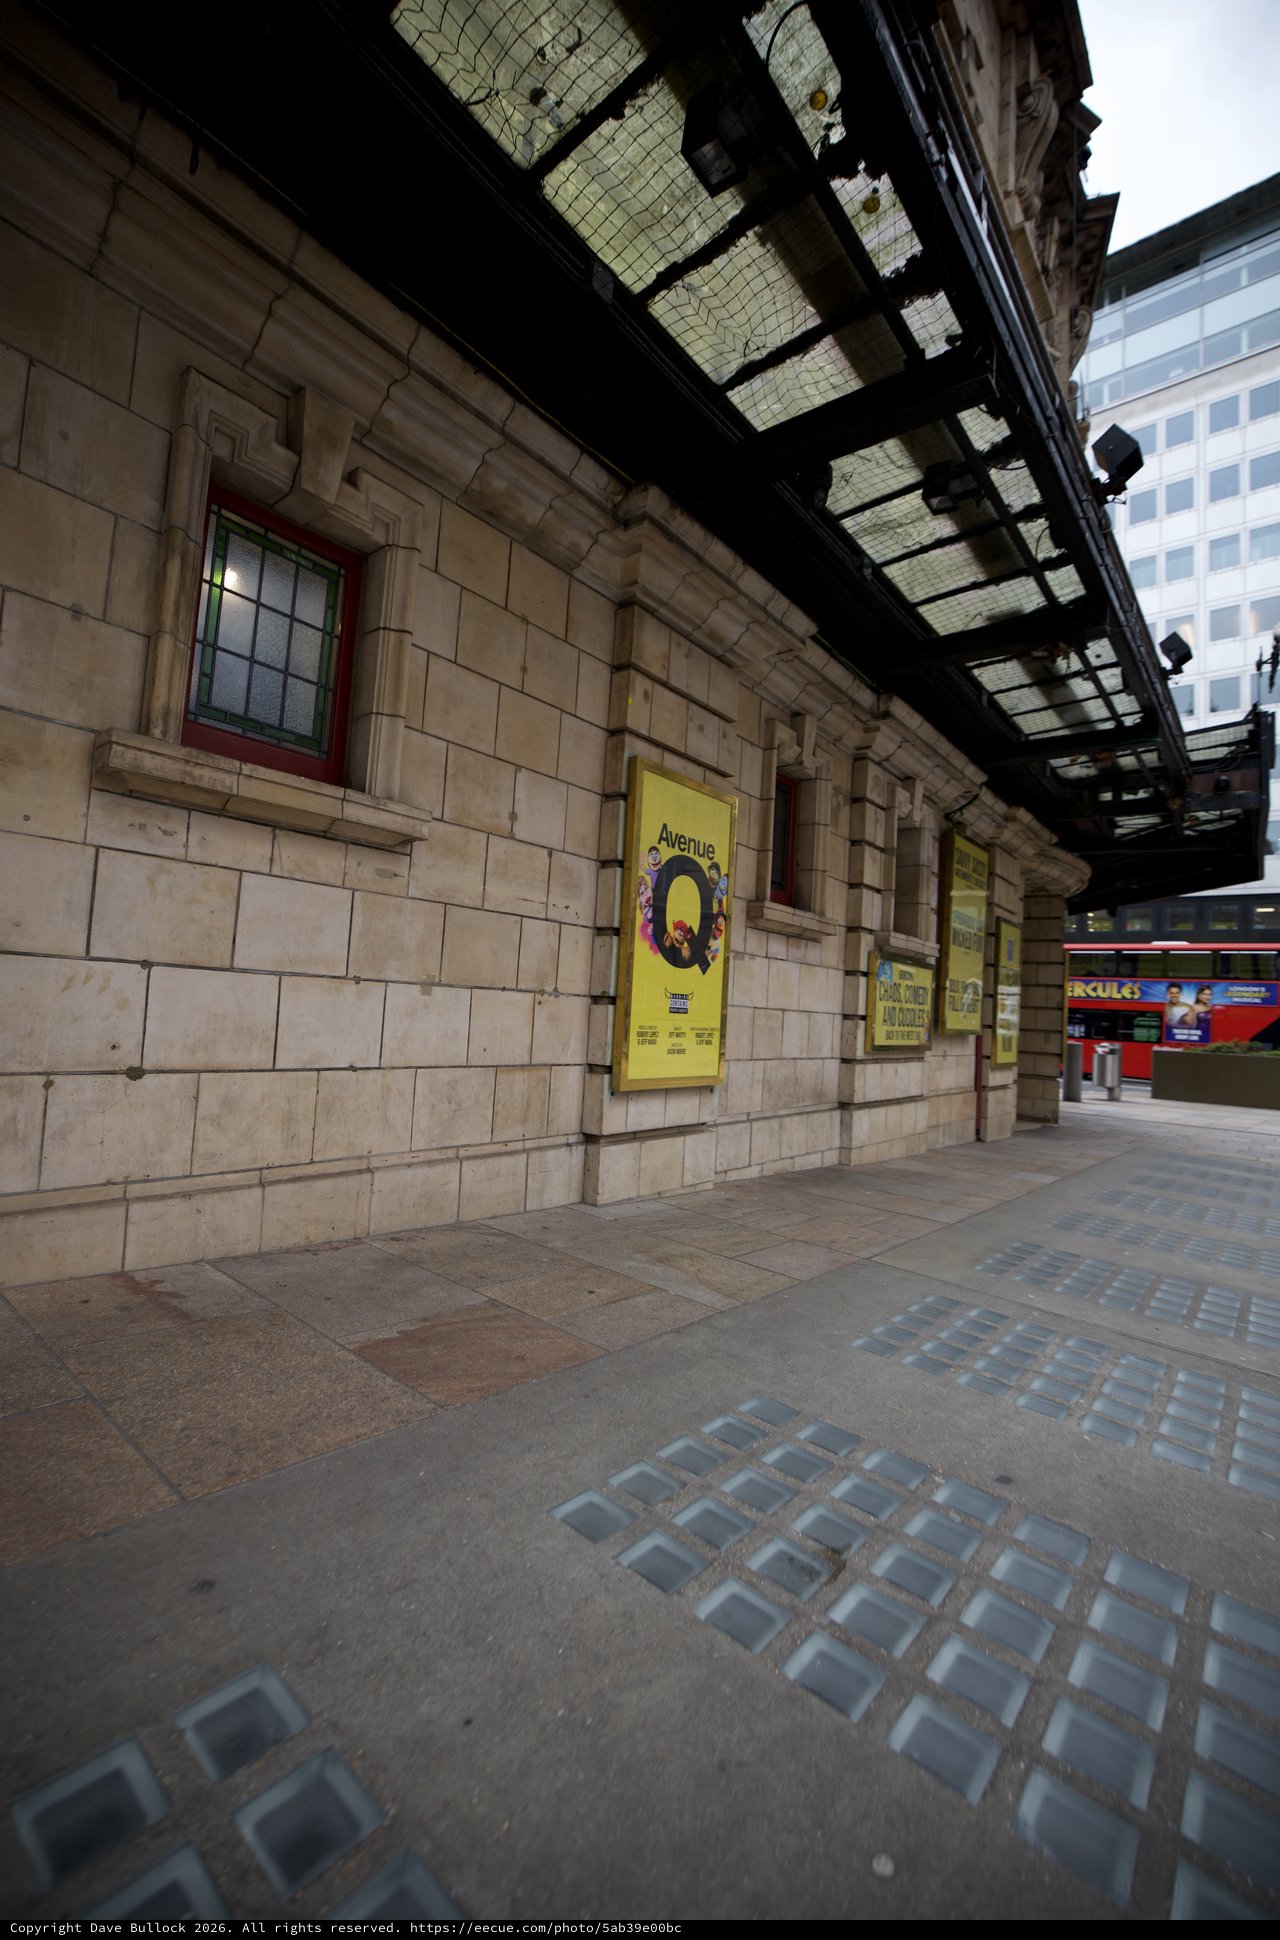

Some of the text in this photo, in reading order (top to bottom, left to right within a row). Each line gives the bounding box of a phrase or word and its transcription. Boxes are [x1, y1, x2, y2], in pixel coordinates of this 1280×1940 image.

[658, 823, 715, 861] Avenue
[652, 854, 714, 976] Q
[1068, 980, 1142, 1000] ERCULES
[882, 1006, 897, 1027] AND
